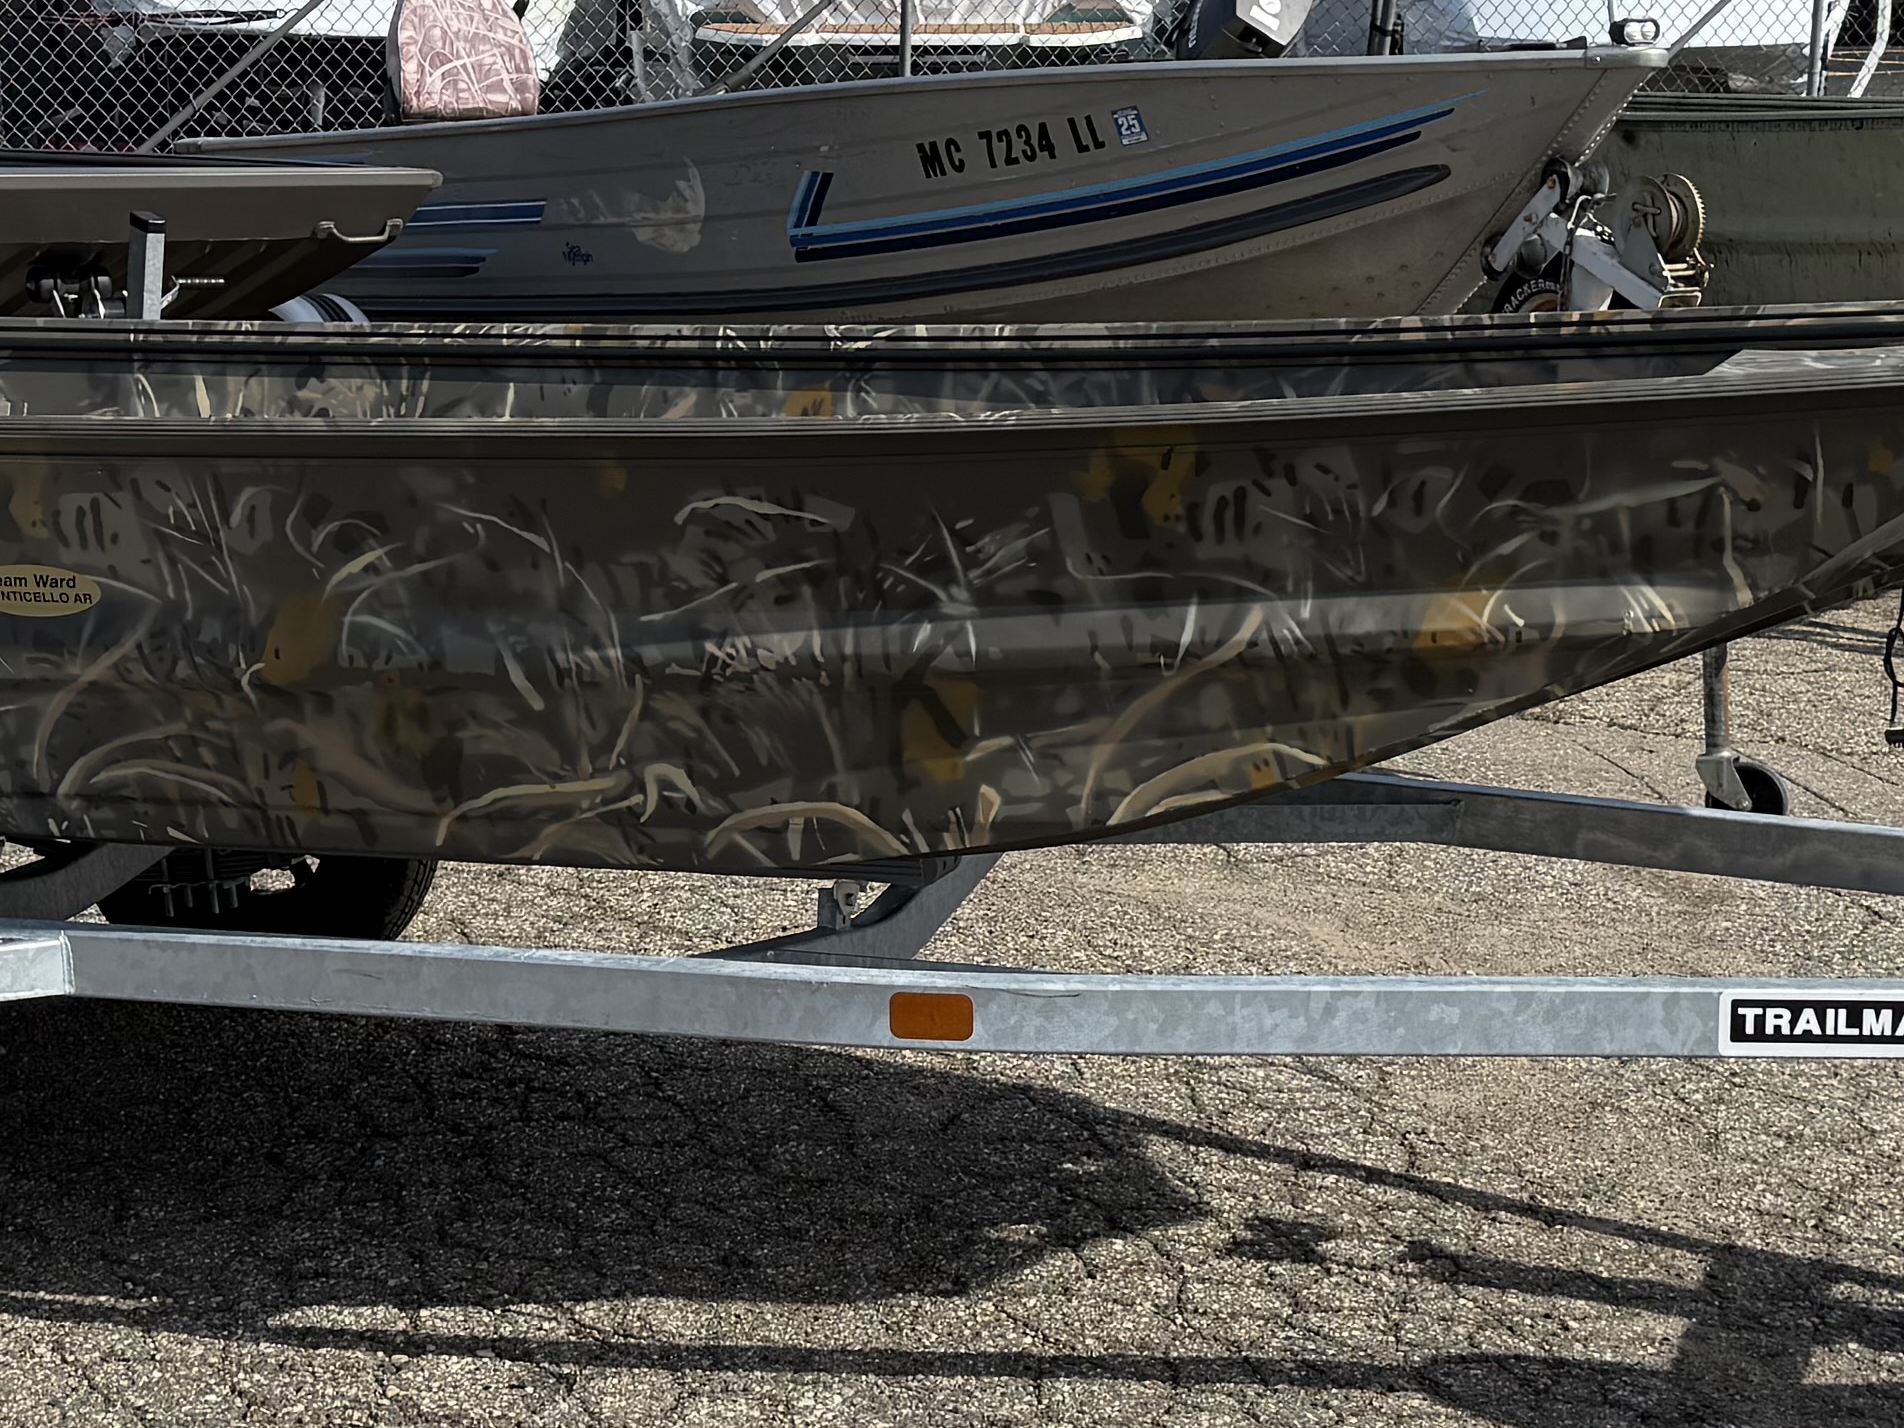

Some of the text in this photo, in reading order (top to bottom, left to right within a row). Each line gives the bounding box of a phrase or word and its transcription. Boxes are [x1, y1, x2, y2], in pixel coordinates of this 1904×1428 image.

[1117, 114, 1141, 136] 25
[915, 114, 1106, 180] MC 7234 LL
[33, 573, 77, 589] Ward
[73, 593, 93, 605] AR
